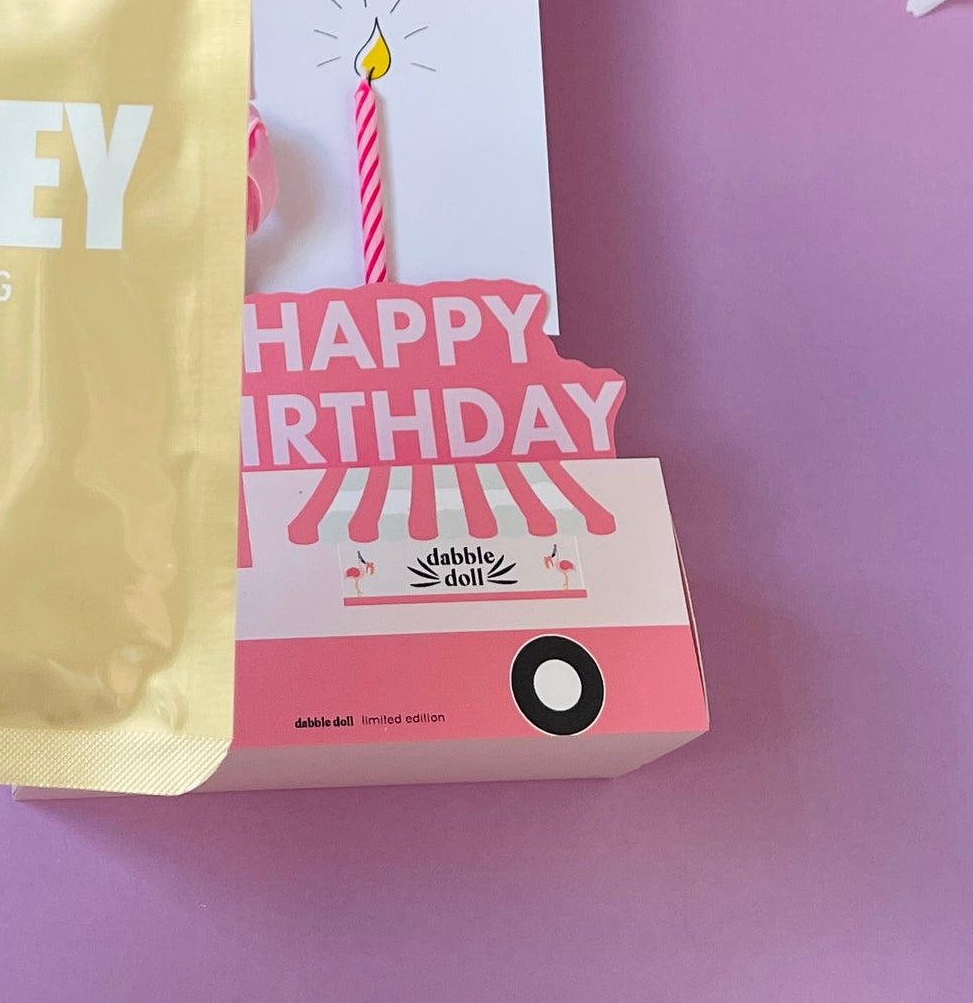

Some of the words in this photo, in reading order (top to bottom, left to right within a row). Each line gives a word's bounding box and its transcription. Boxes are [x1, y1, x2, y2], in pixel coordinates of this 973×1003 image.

[243, 293, 542, 373] HAPPY
[240, 380, 626, 467] IRTHDAY
[426, 546, 496, 566] dabble
[444, 568, 484, 587] doll
[294, 716, 332, 729] dabble
[333, 715, 354, 727] doll
[361, 713, 402, 726] limited
[405, 712, 446, 724] edition
